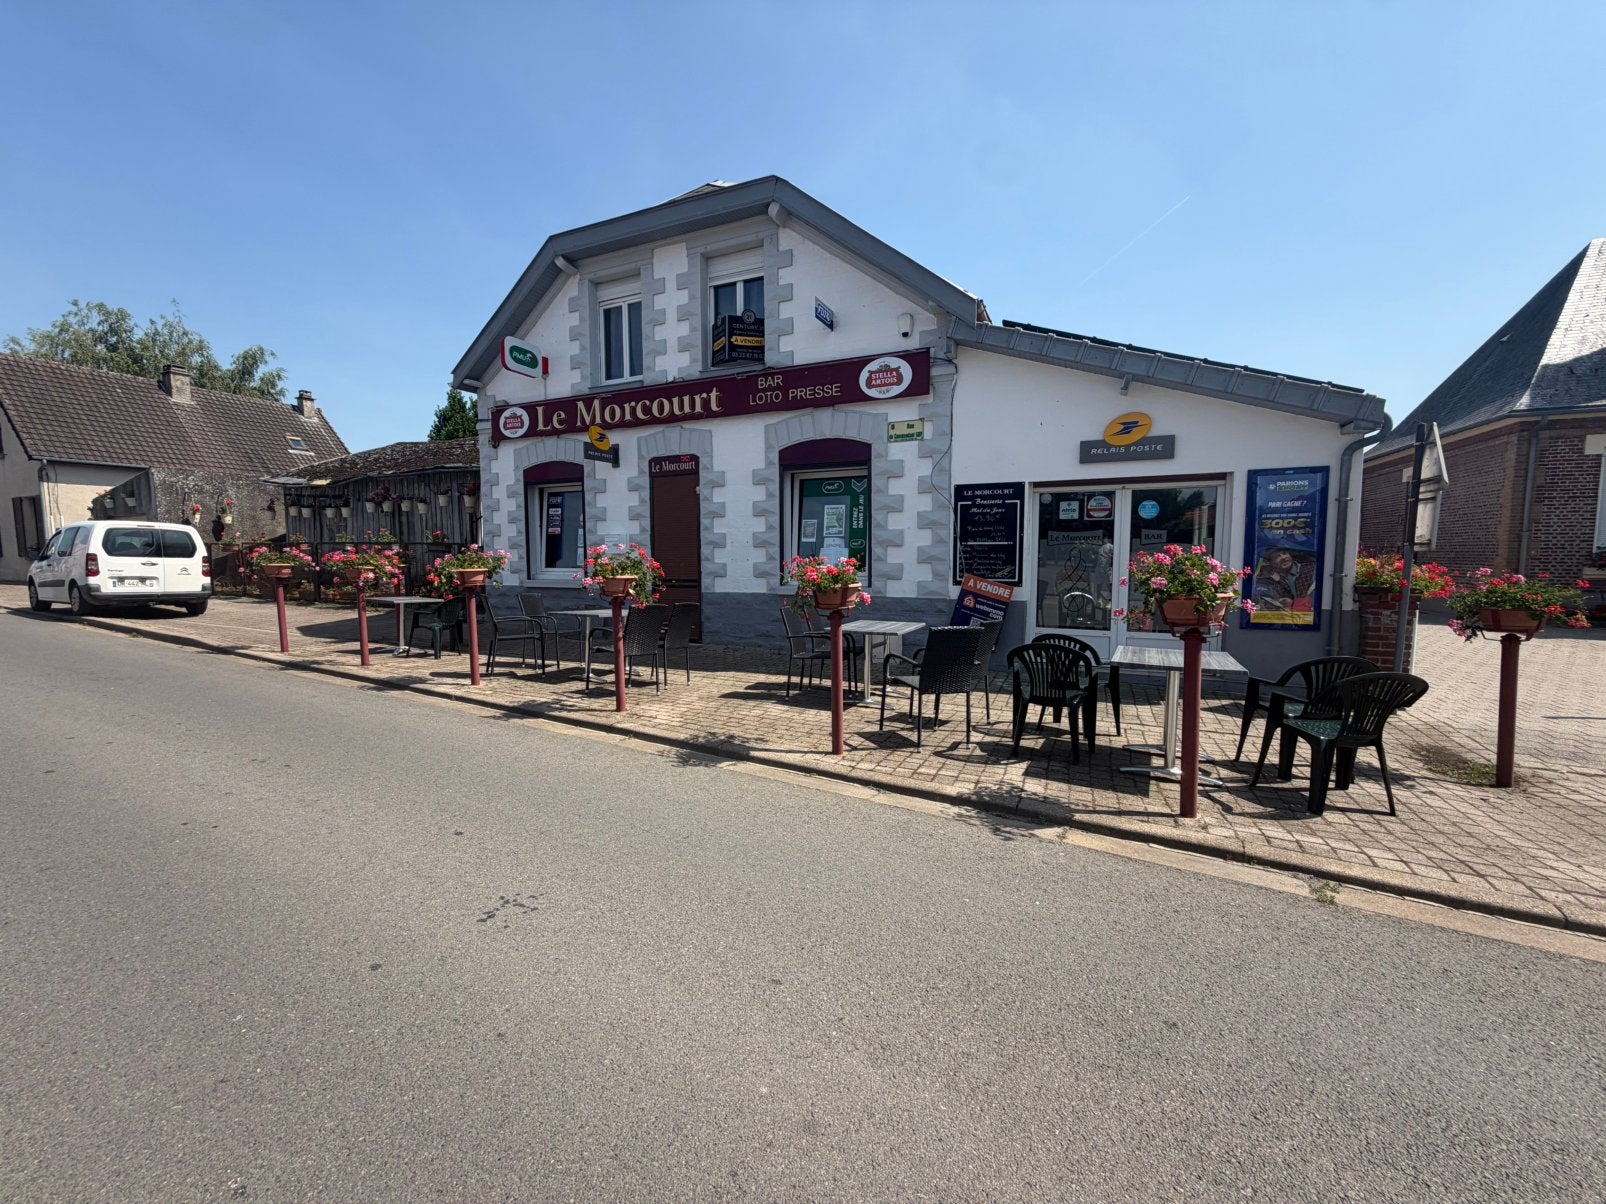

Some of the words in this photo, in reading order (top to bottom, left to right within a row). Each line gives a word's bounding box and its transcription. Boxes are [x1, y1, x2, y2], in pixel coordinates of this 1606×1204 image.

[732, 323, 758, 331] CENTURY
[512, 351, 527, 361] PMU
[870, 377, 897, 385] ARTOIS
[871, 371, 897, 379] STELLA
[758, 375, 783, 389] BAR
[750, 391, 782, 405] LOTO
[789, 384, 841, 401] PRESSE
[535, 406, 568, 431] Le
[575, 386, 724, 428] Morcourt
[1090, 446, 1125, 455] RELAIS
[1130, 443, 1164, 452] POSTE
[651, 462, 660, 473] Le
[661, 461, 696, 472] Morcourt
[968, 578, 974, 587] A
[976, 580, 1011, 598] VENDRE
